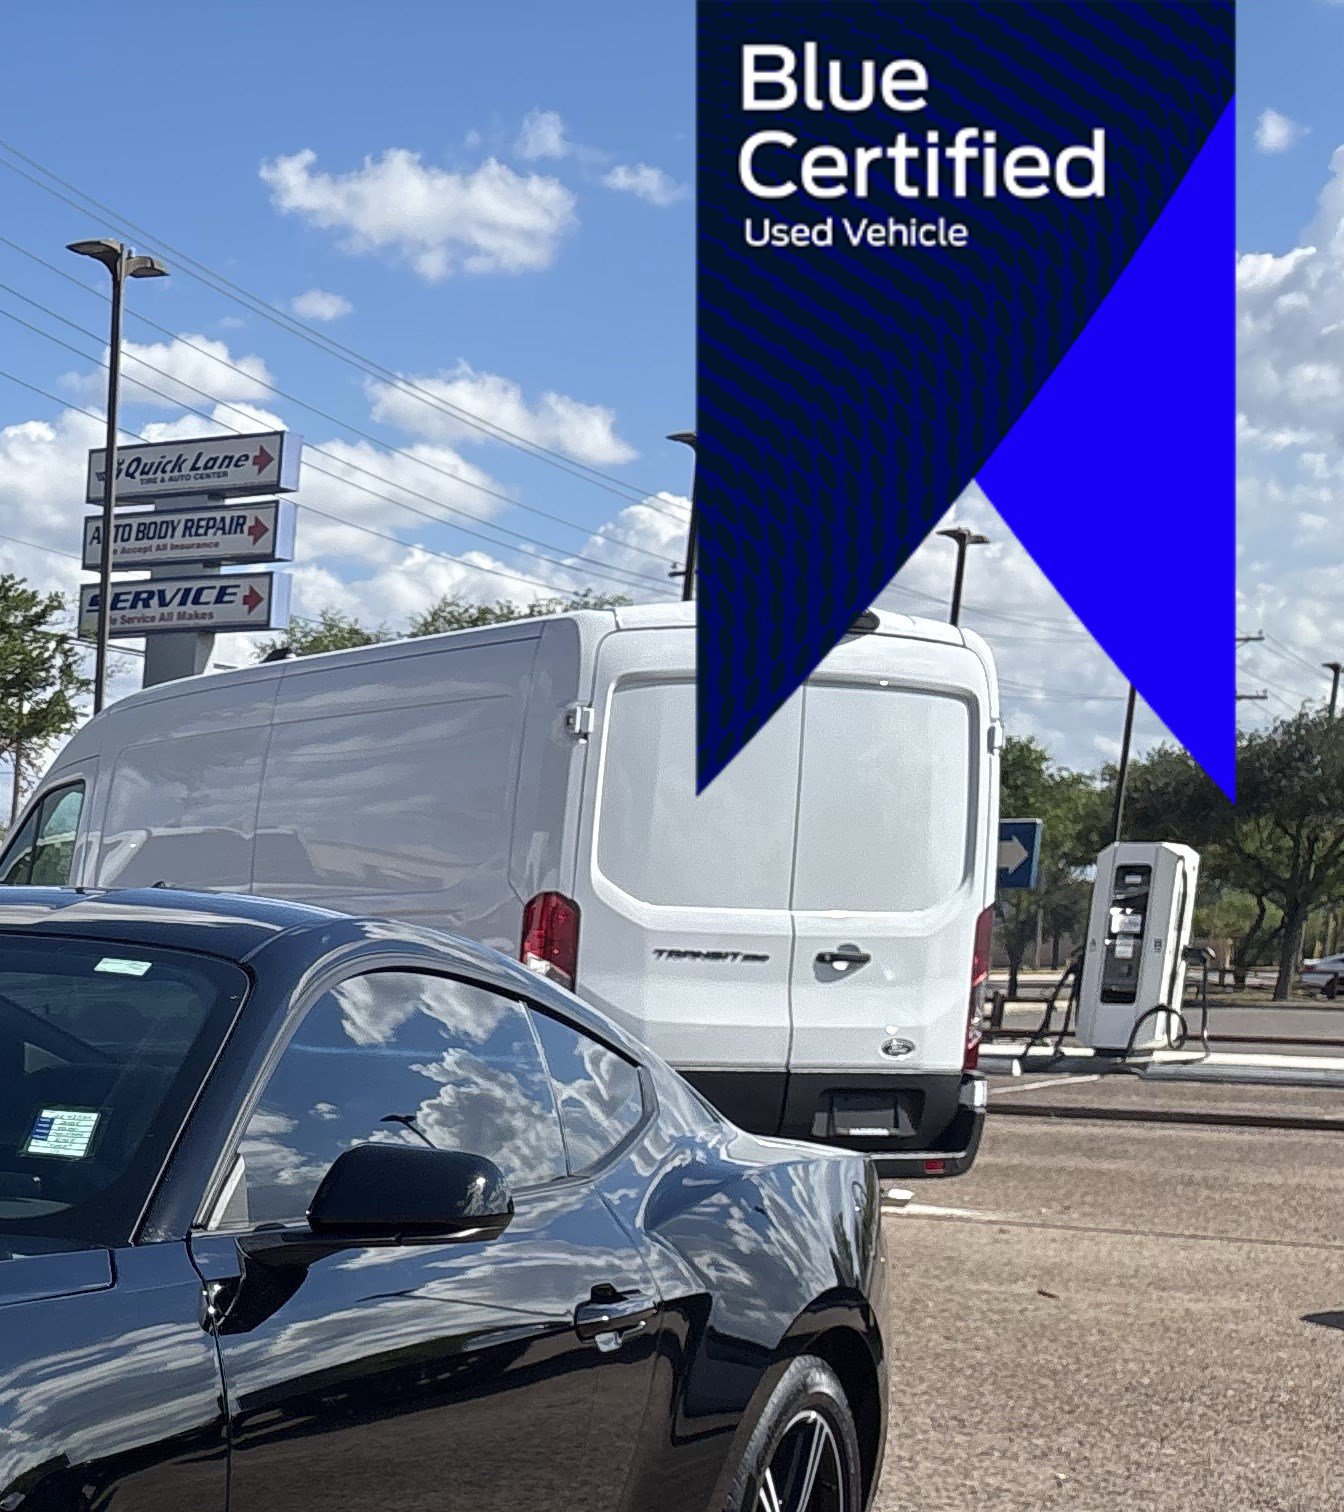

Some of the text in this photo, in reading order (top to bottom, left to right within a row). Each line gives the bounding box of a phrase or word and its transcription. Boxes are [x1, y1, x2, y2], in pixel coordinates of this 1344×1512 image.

[125, 451, 250, 479] Quick Lane
[140, 477, 158, 485] TIRE
[167, 474, 192, 482] AUTO
[192, 470, 229, 480] CENTER
[88, 514, 248, 546] ATO BODY REPAIR
[170, 541, 221, 552] Insurance
[119, 612, 157, 625] Service
[157, 611, 175, 622] All
[175, 610, 215, 622] Makes
